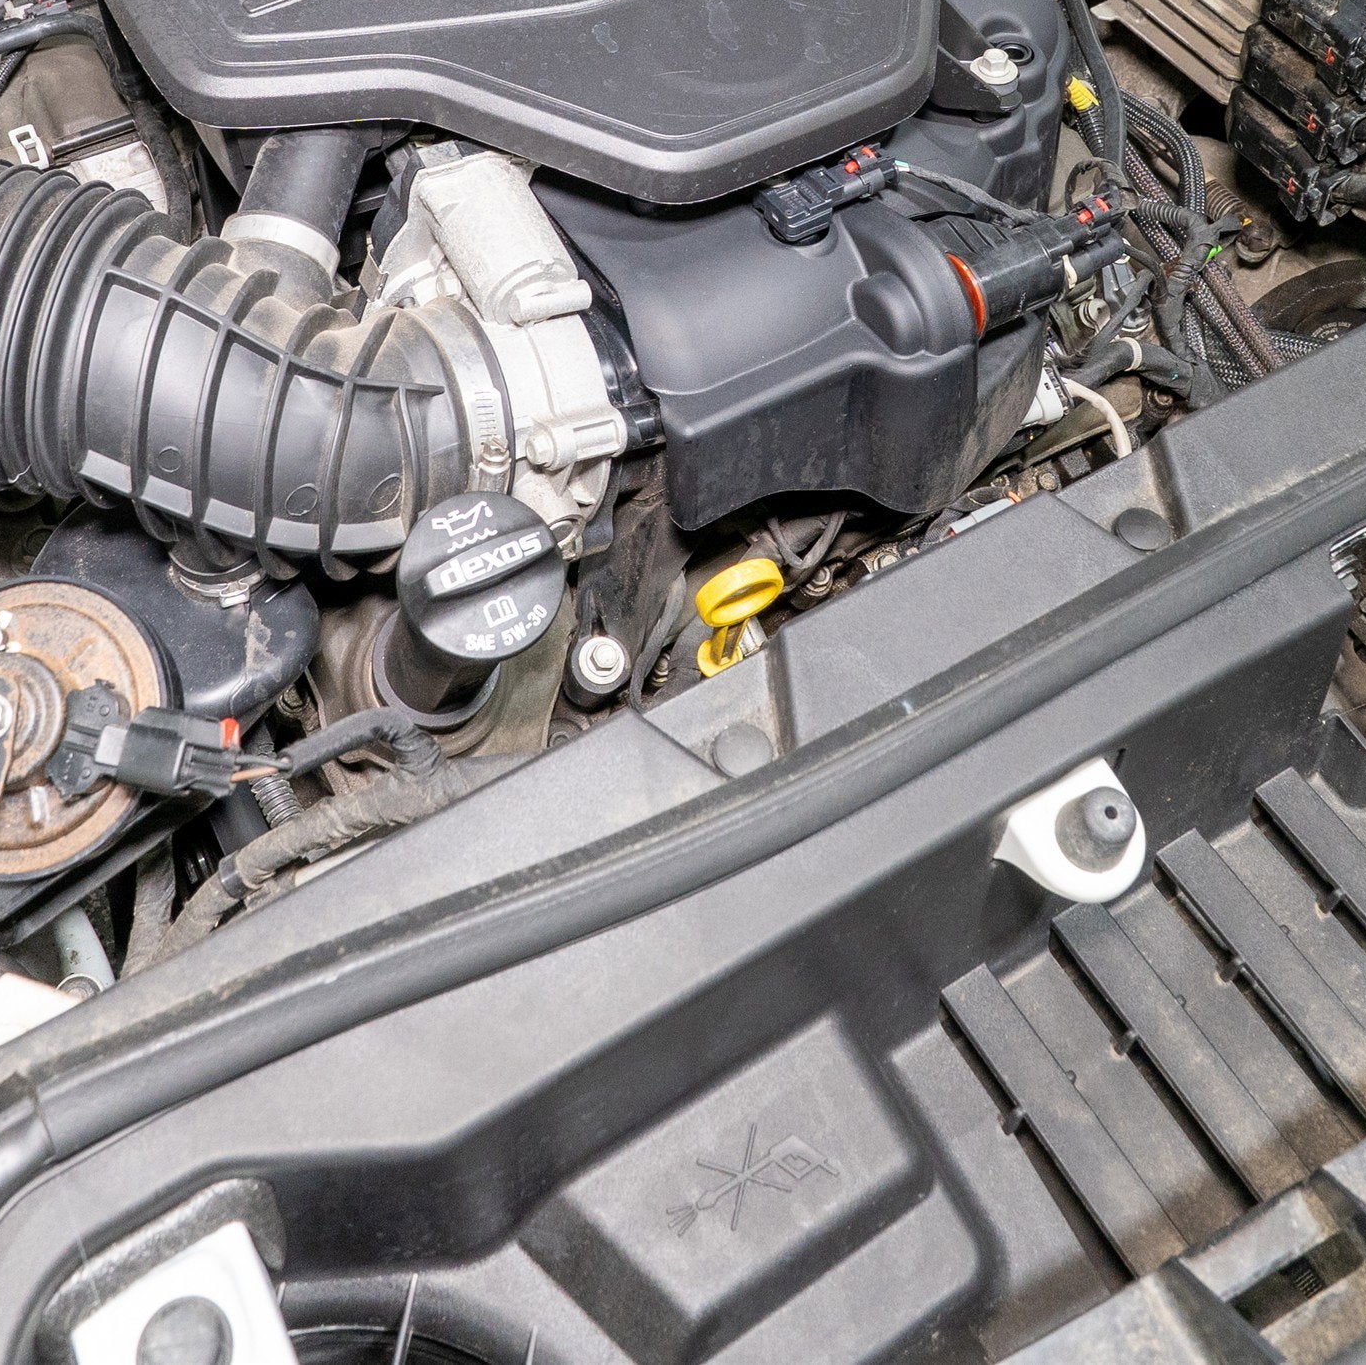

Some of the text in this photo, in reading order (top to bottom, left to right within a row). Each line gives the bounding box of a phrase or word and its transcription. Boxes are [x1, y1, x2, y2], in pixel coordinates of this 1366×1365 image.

[439, 532, 543, 590] dexos
[464, 603, 548, 652] SAE 5W-30
